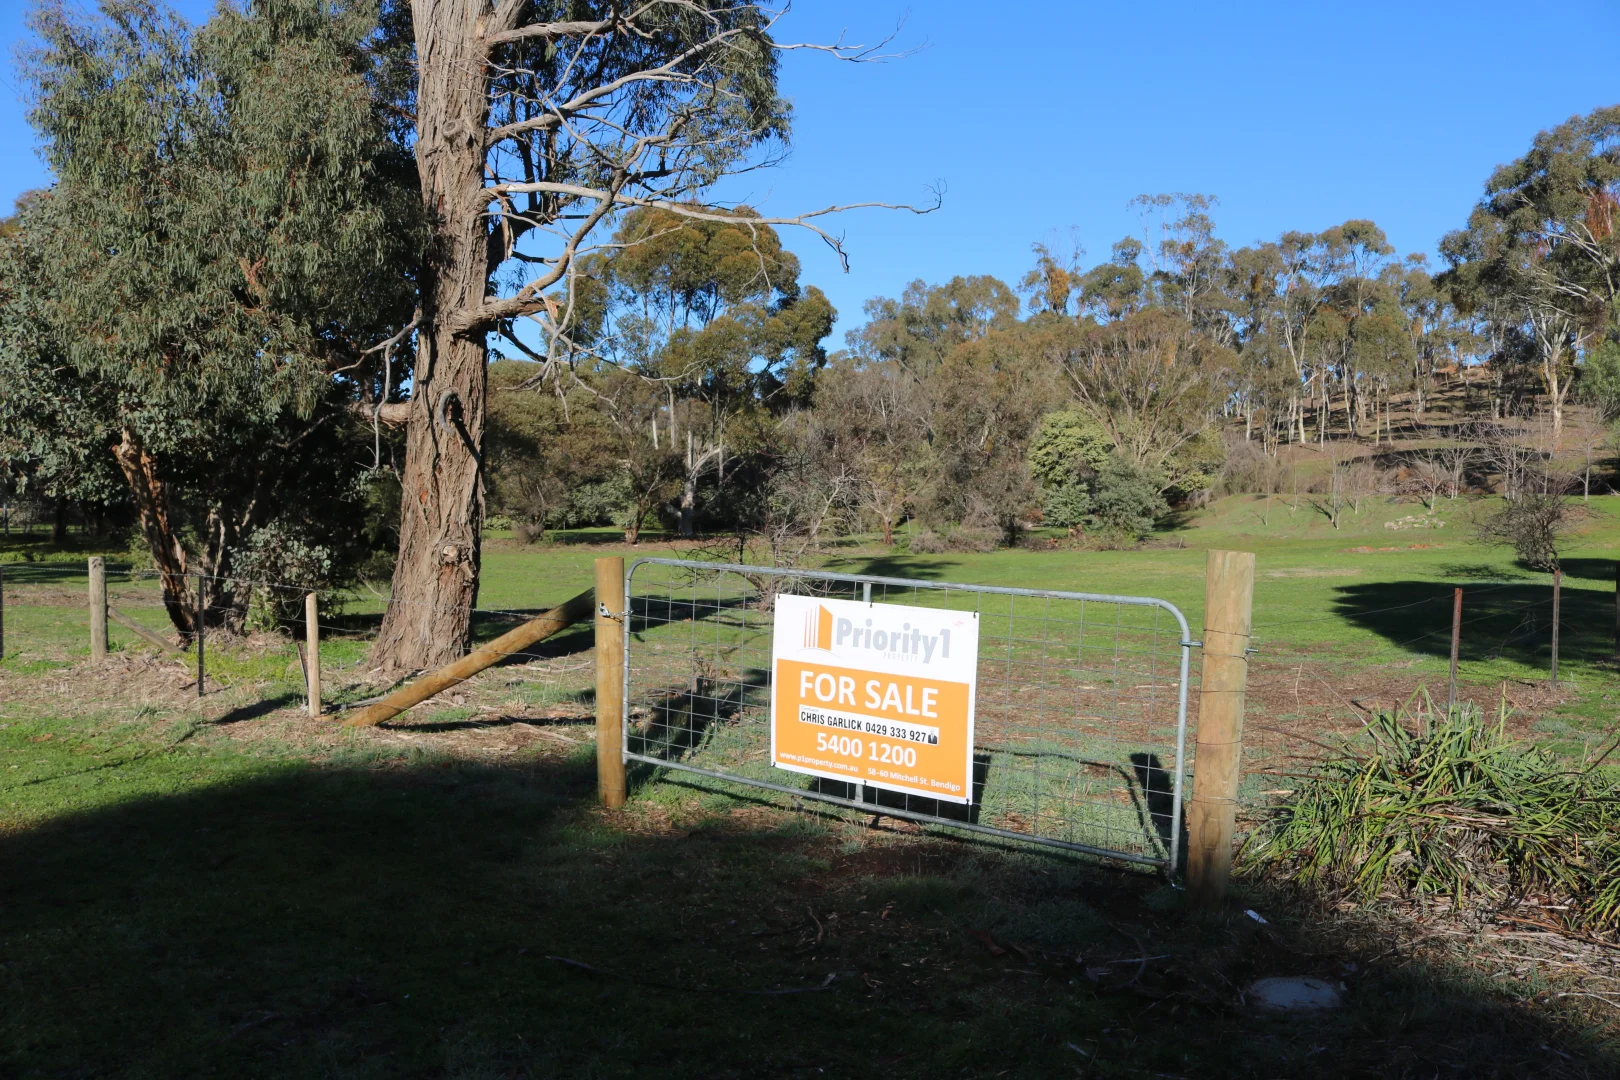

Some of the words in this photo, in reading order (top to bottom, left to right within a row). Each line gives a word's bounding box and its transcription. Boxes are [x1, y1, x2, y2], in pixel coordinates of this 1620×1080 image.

[836, 617, 950, 664] Priority1
[883, 651, 919, 663] PROPERTY
[800, 670, 856, 706] FOR
[864, 680, 939, 718] SALE
[800, 711, 825, 726] CHRIS
[827, 716, 862, 731] GARLICK
[865, 722, 887, 736] 0429
[890, 726, 907, 739] 333
[909, 730, 926, 743] 927
[779, 751, 859, 773] www.p1property.com.au
[816, 732, 863, 758] 5400
[868, 741, 917, 768] 1200
[867, 767, 889, 778] 58-60
[889, 771, 919, 784] Mitchell
[930, 779, 961, 792] Bendigo
